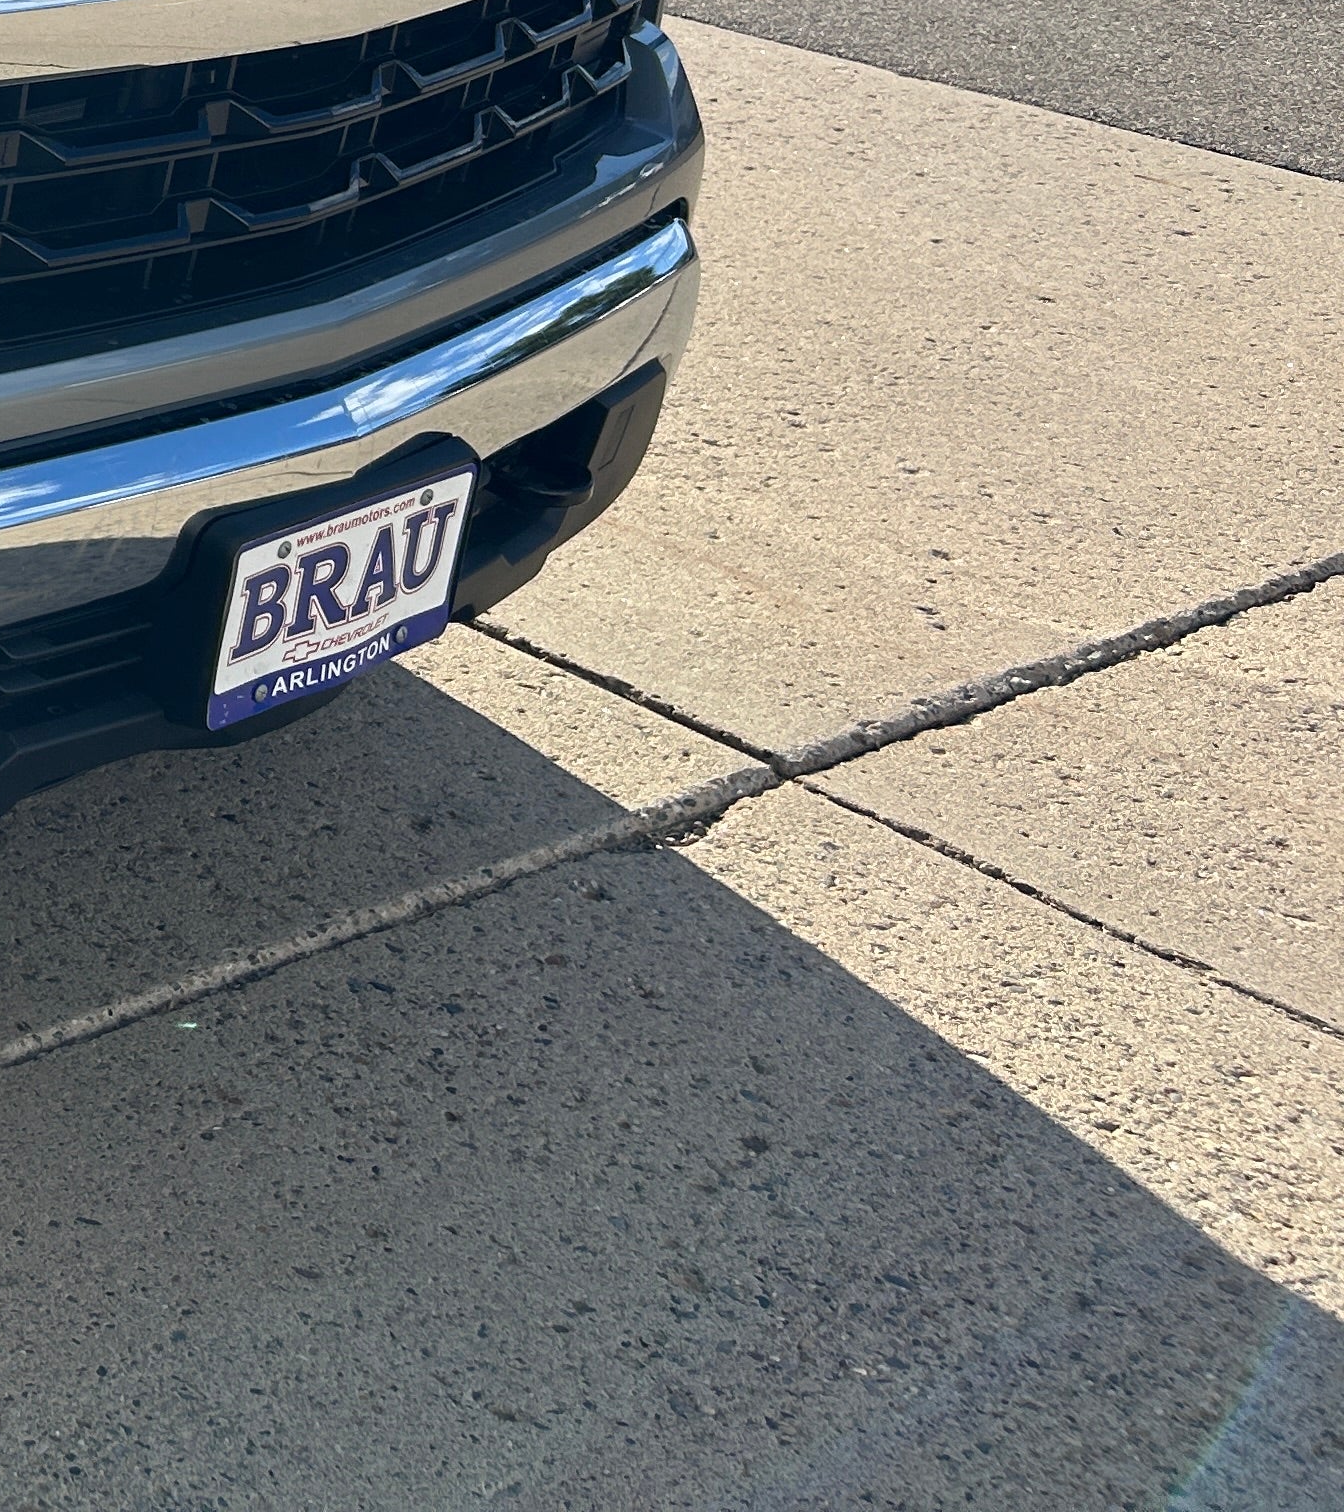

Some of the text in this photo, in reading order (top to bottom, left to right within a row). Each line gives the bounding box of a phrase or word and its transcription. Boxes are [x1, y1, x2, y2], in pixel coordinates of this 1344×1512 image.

[296, 498, 415, 546] www.braumotors.com
[227, 498, 459, 666] BRAU
[320, 613, 389, 651] CHEVROLET
[271, 633, 391, 697] ARLINGTON
